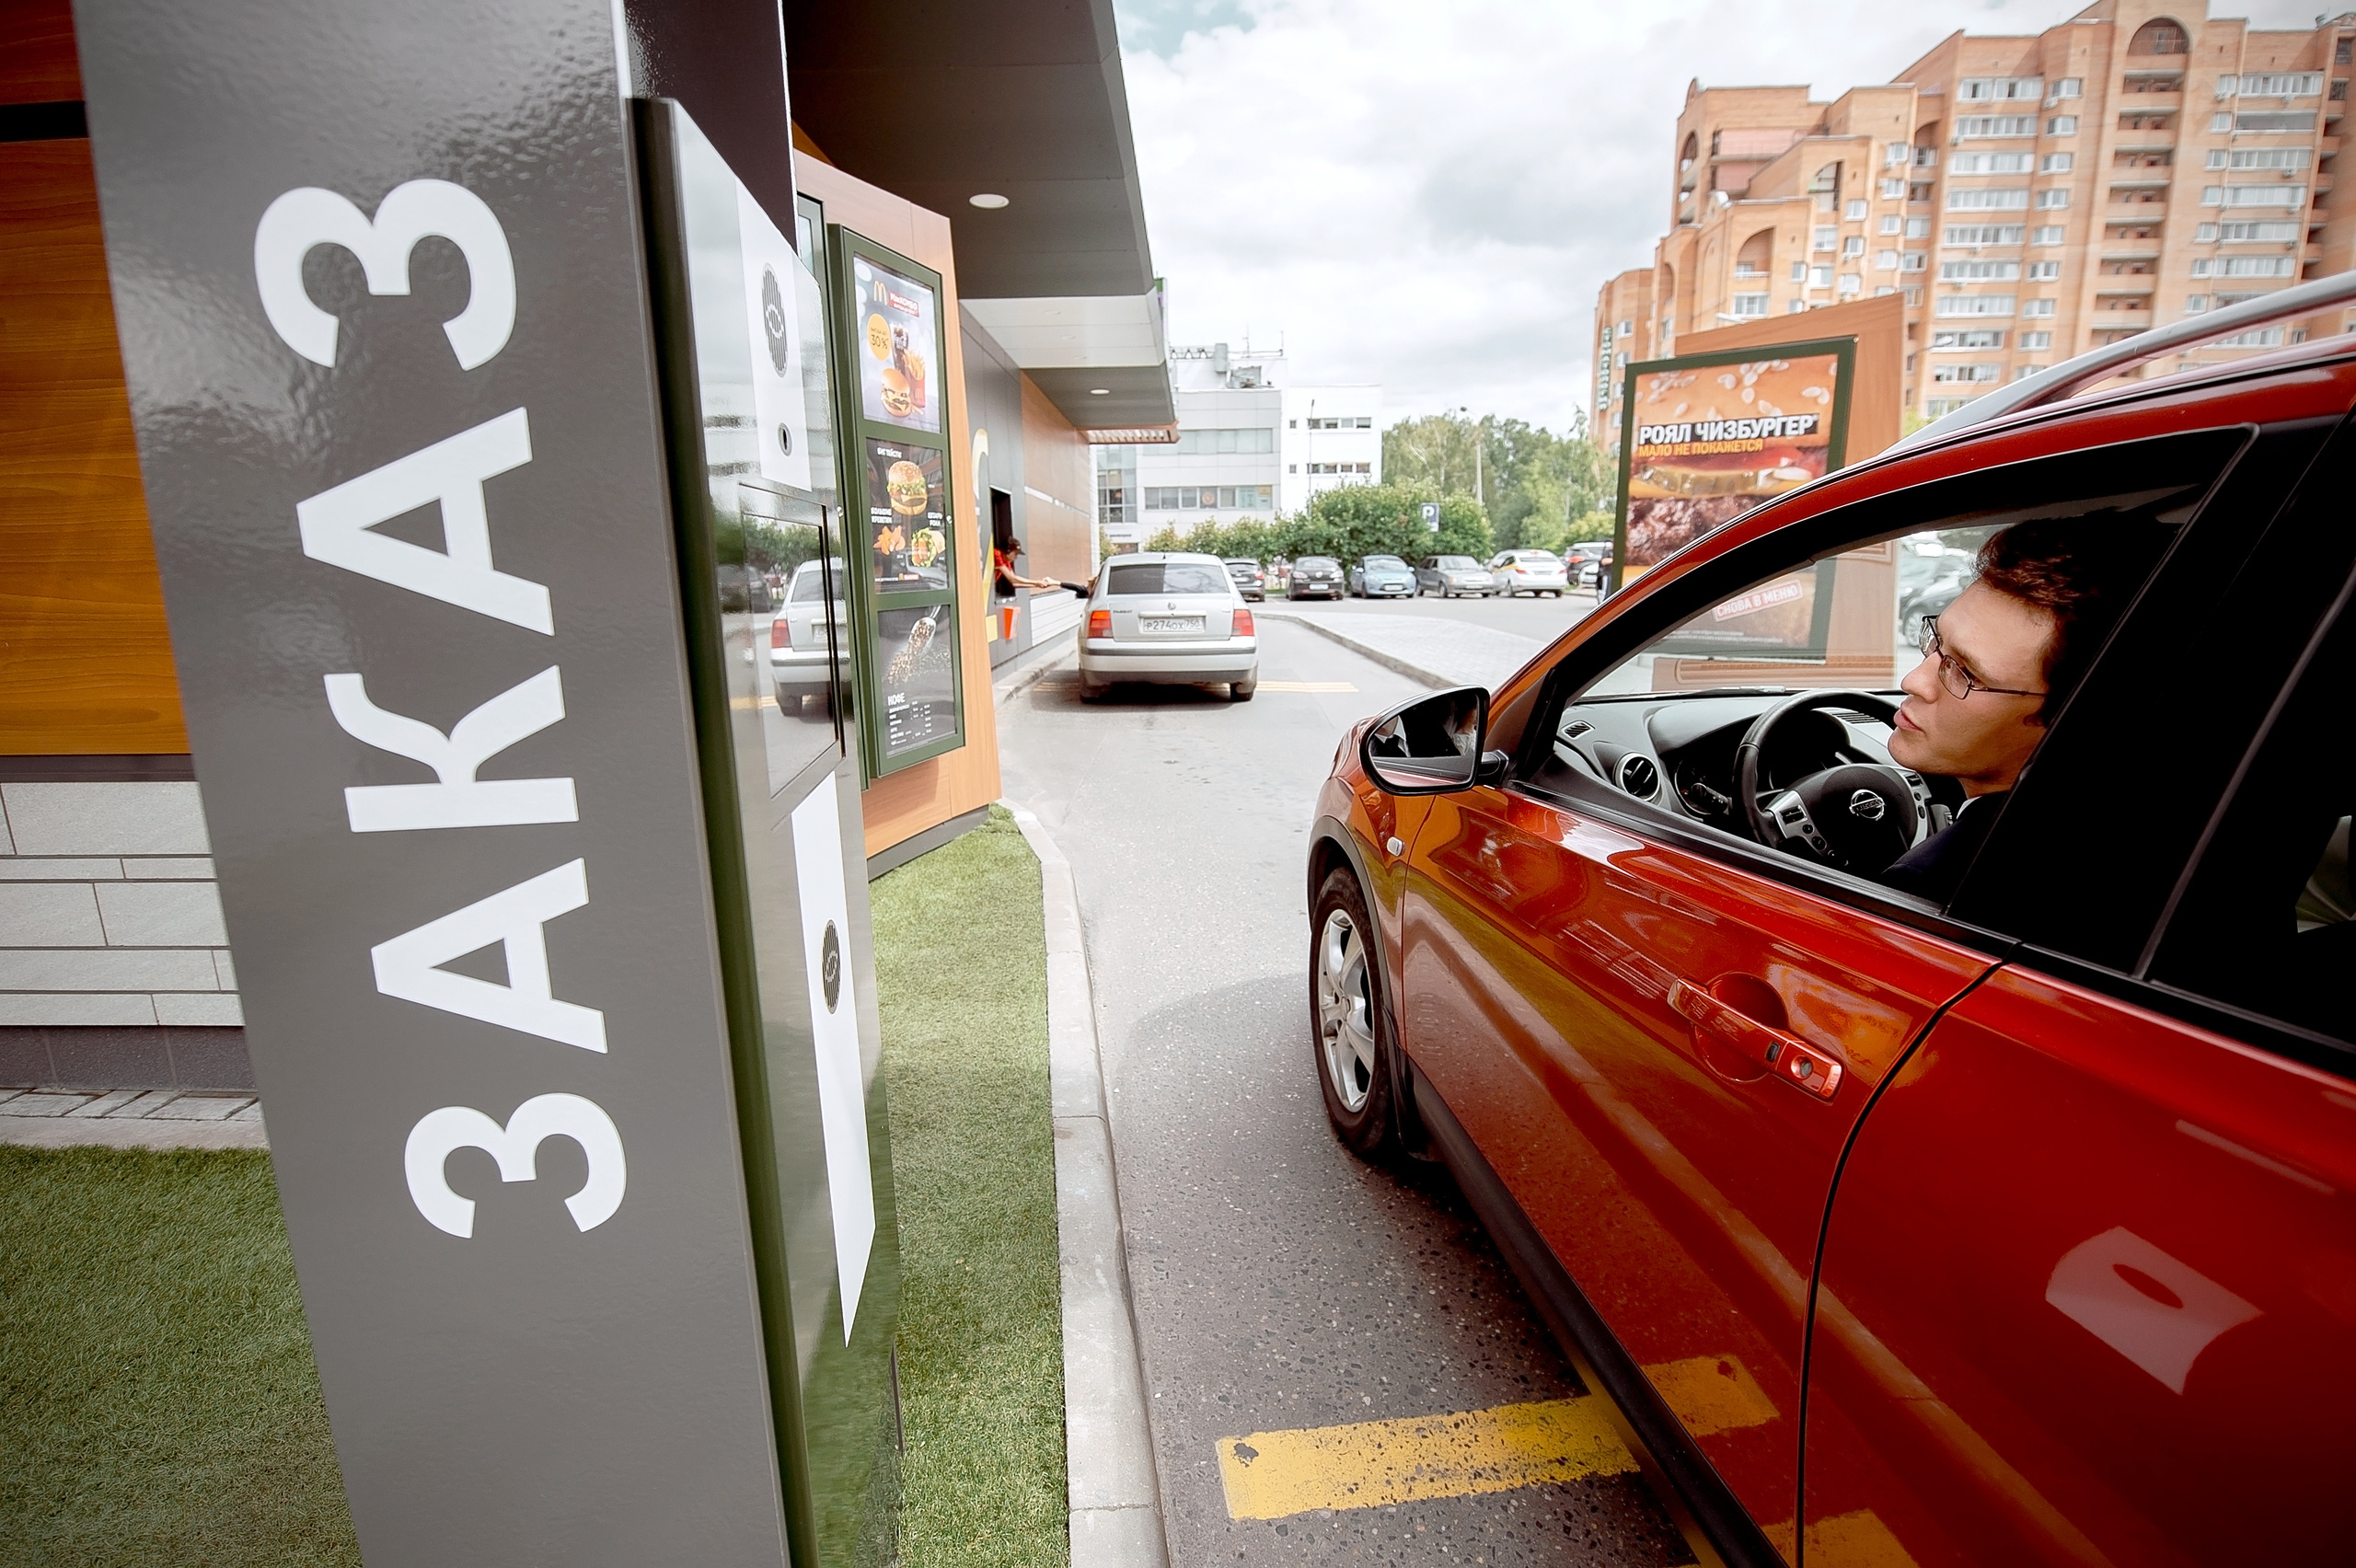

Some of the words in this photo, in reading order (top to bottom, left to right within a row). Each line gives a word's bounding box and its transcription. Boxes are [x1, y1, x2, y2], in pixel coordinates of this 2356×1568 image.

[1639, 423, 1692, 445] РОЯЛ
[1638, 444, 1672, 457] МАЛО
[1675, 443, 1691, 455] НЕ
[1692, 439, 1763, 455] ПОКАЖЕТСЯ
[1422, 506, 1435, 519] P
[1716, 599, 1752, 617] СНОВА
[1752, 595, 1762, 606] В
[1763, 586, 1797, 604] МЕНЮ
[255, 179, 628, 1239] ЗАКАЗ
